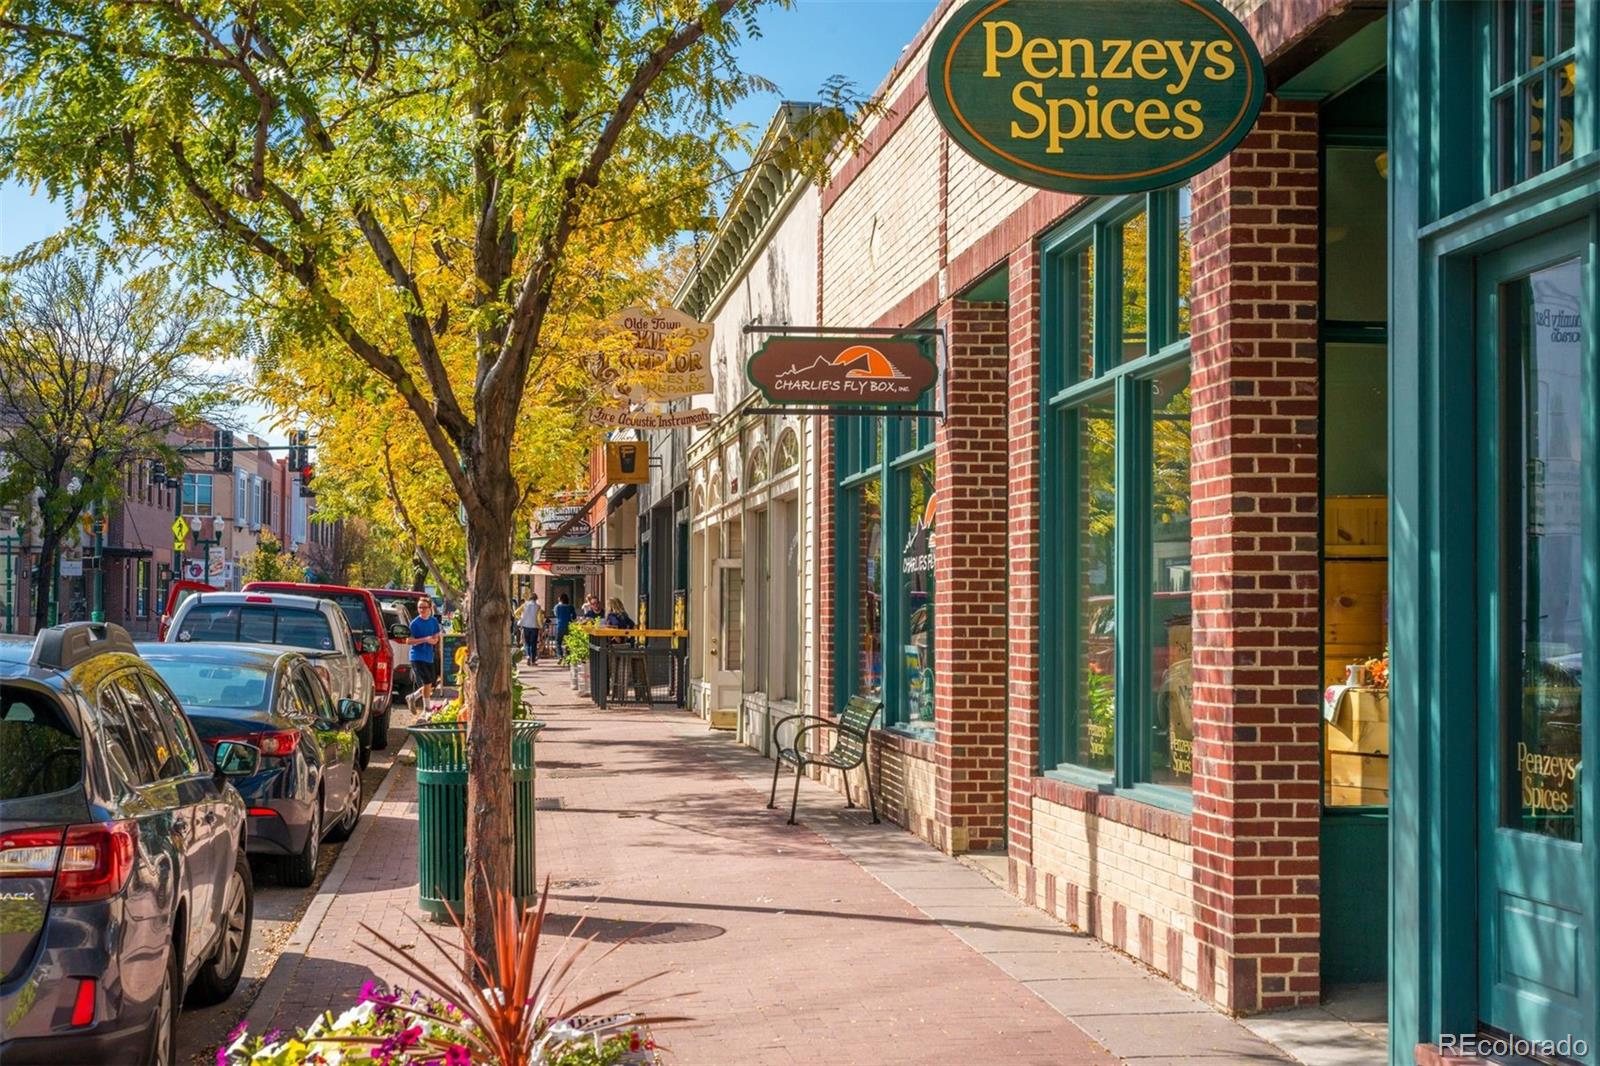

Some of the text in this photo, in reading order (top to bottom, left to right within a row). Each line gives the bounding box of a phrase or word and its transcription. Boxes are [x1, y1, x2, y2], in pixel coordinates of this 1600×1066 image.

[982, 20, 1236, 95] Penzeys
[1010, 81, 1204, 154] Spices
[624, 317, 681, 330] Olde Town
[647, 384, 705, 395] REPAIRS
[775, 379, 840, 391] CHARLIE'S
[843, 381, 869, 395] FLY
[870, 381, 897, 393] BOX,
[658, 411, 710, 427] Instruments
[1516, 741, 1576, 788] Penzeys
[1523, 775, 1569, 818] Spices
